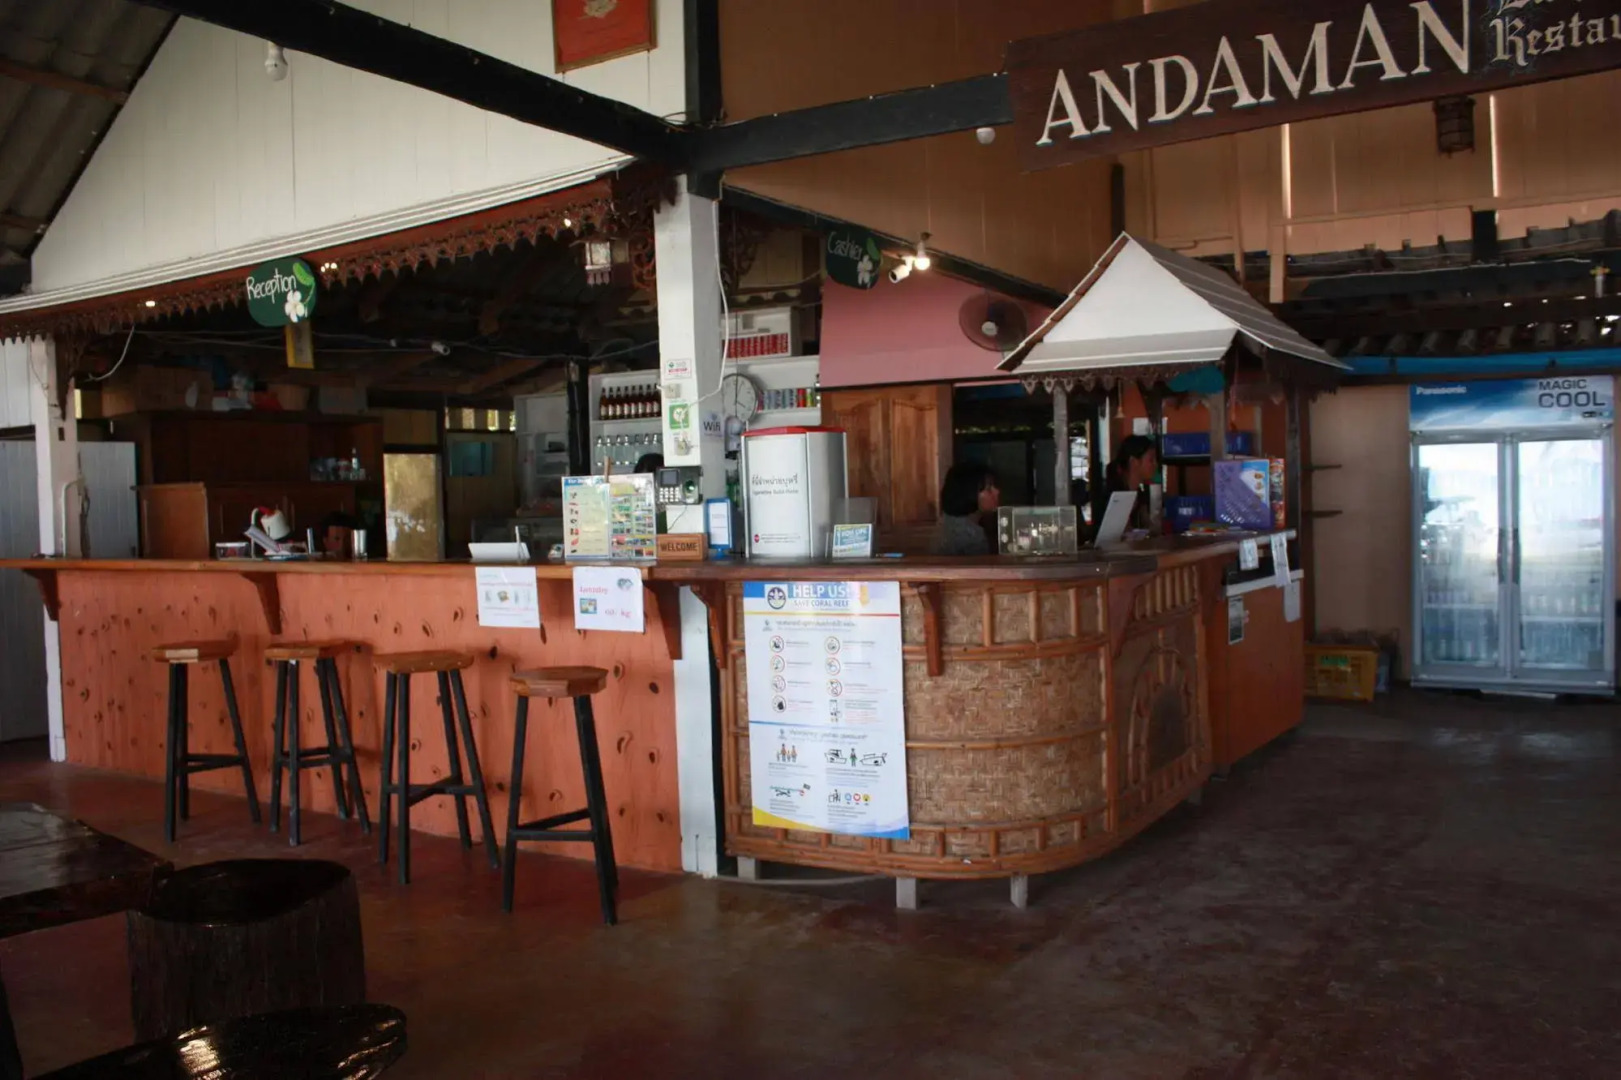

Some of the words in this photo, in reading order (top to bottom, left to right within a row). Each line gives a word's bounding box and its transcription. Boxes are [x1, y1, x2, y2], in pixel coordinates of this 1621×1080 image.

[1036, 0, 1471, 146] ANDAMAN
[246, 267, 297, 304] Reception
[1416, 385, 1467, 395] Panasonic
[1538, 379, 1587, 391] MAGIC
[1538, 391, 1606, 408] COOL
[660, 543, 698, 551] WELCOME
[793, 585, 824, 598] HELP
